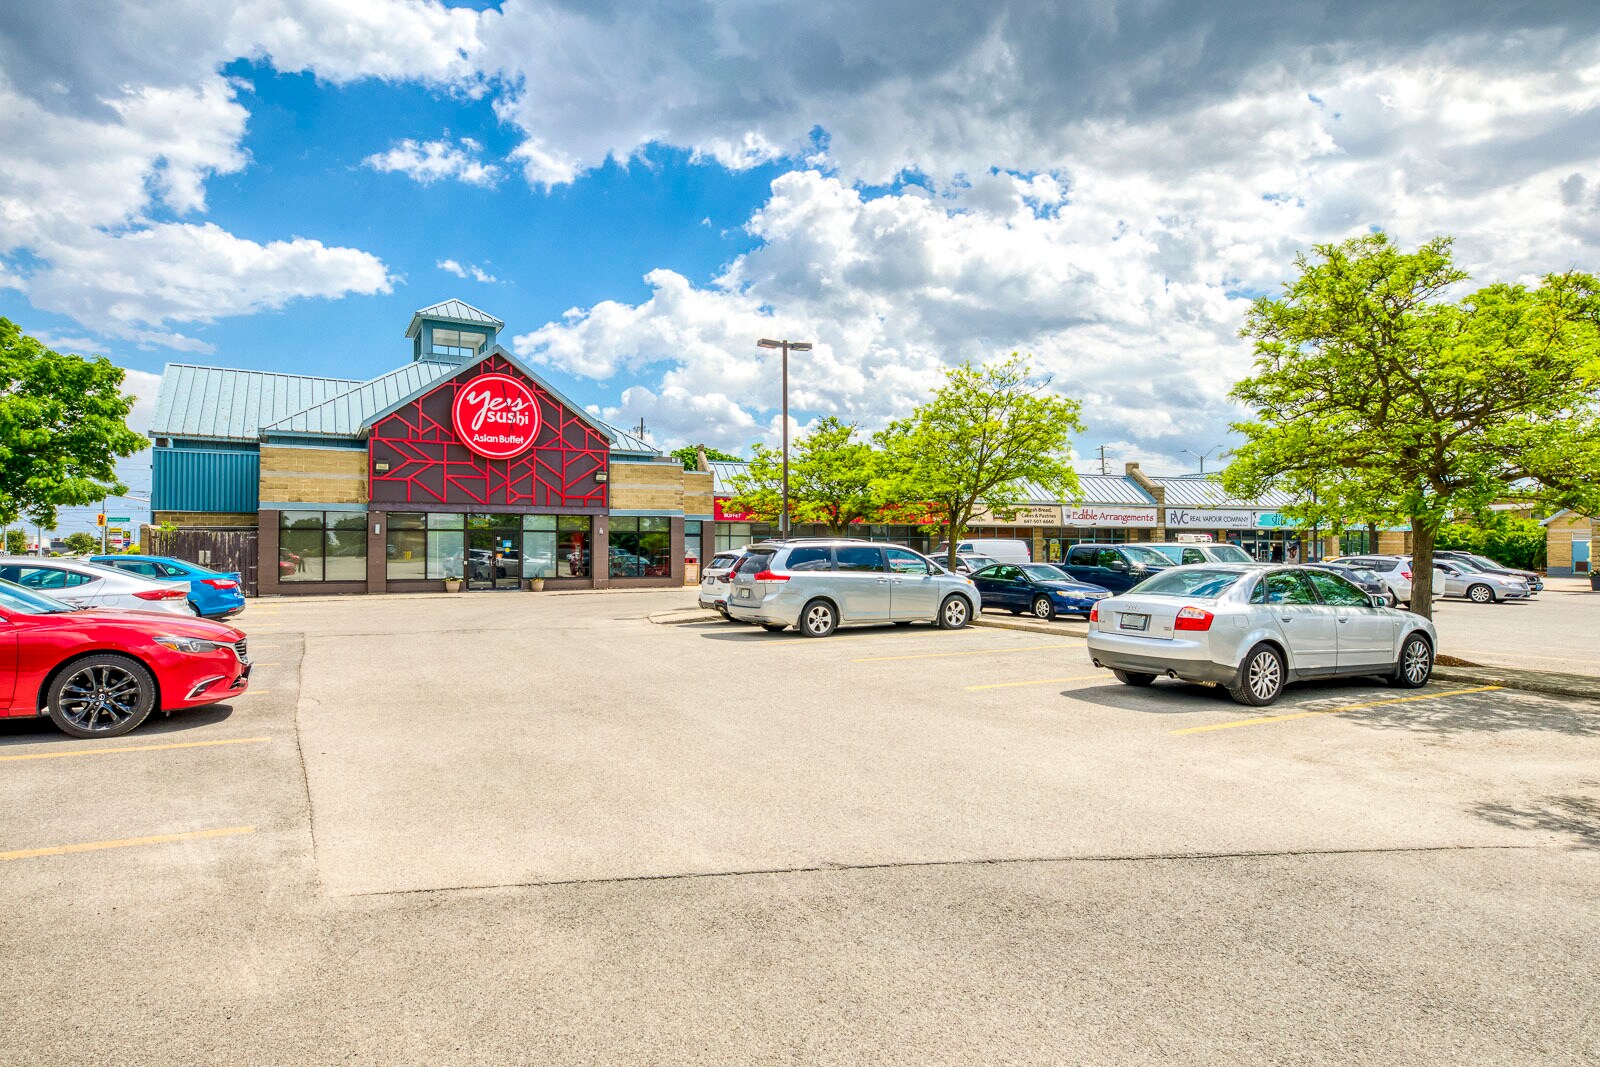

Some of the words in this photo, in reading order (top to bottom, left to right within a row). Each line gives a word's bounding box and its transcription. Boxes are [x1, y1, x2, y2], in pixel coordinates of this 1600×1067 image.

[473, 433, 498, 443] Asian
[499, 435, 524, 444] Buffet
[1072, 509, 1098, 520] Edible
[1099, 512, 1154, 524] Arrangements
[1170, 510, 1189, 526] RVC
